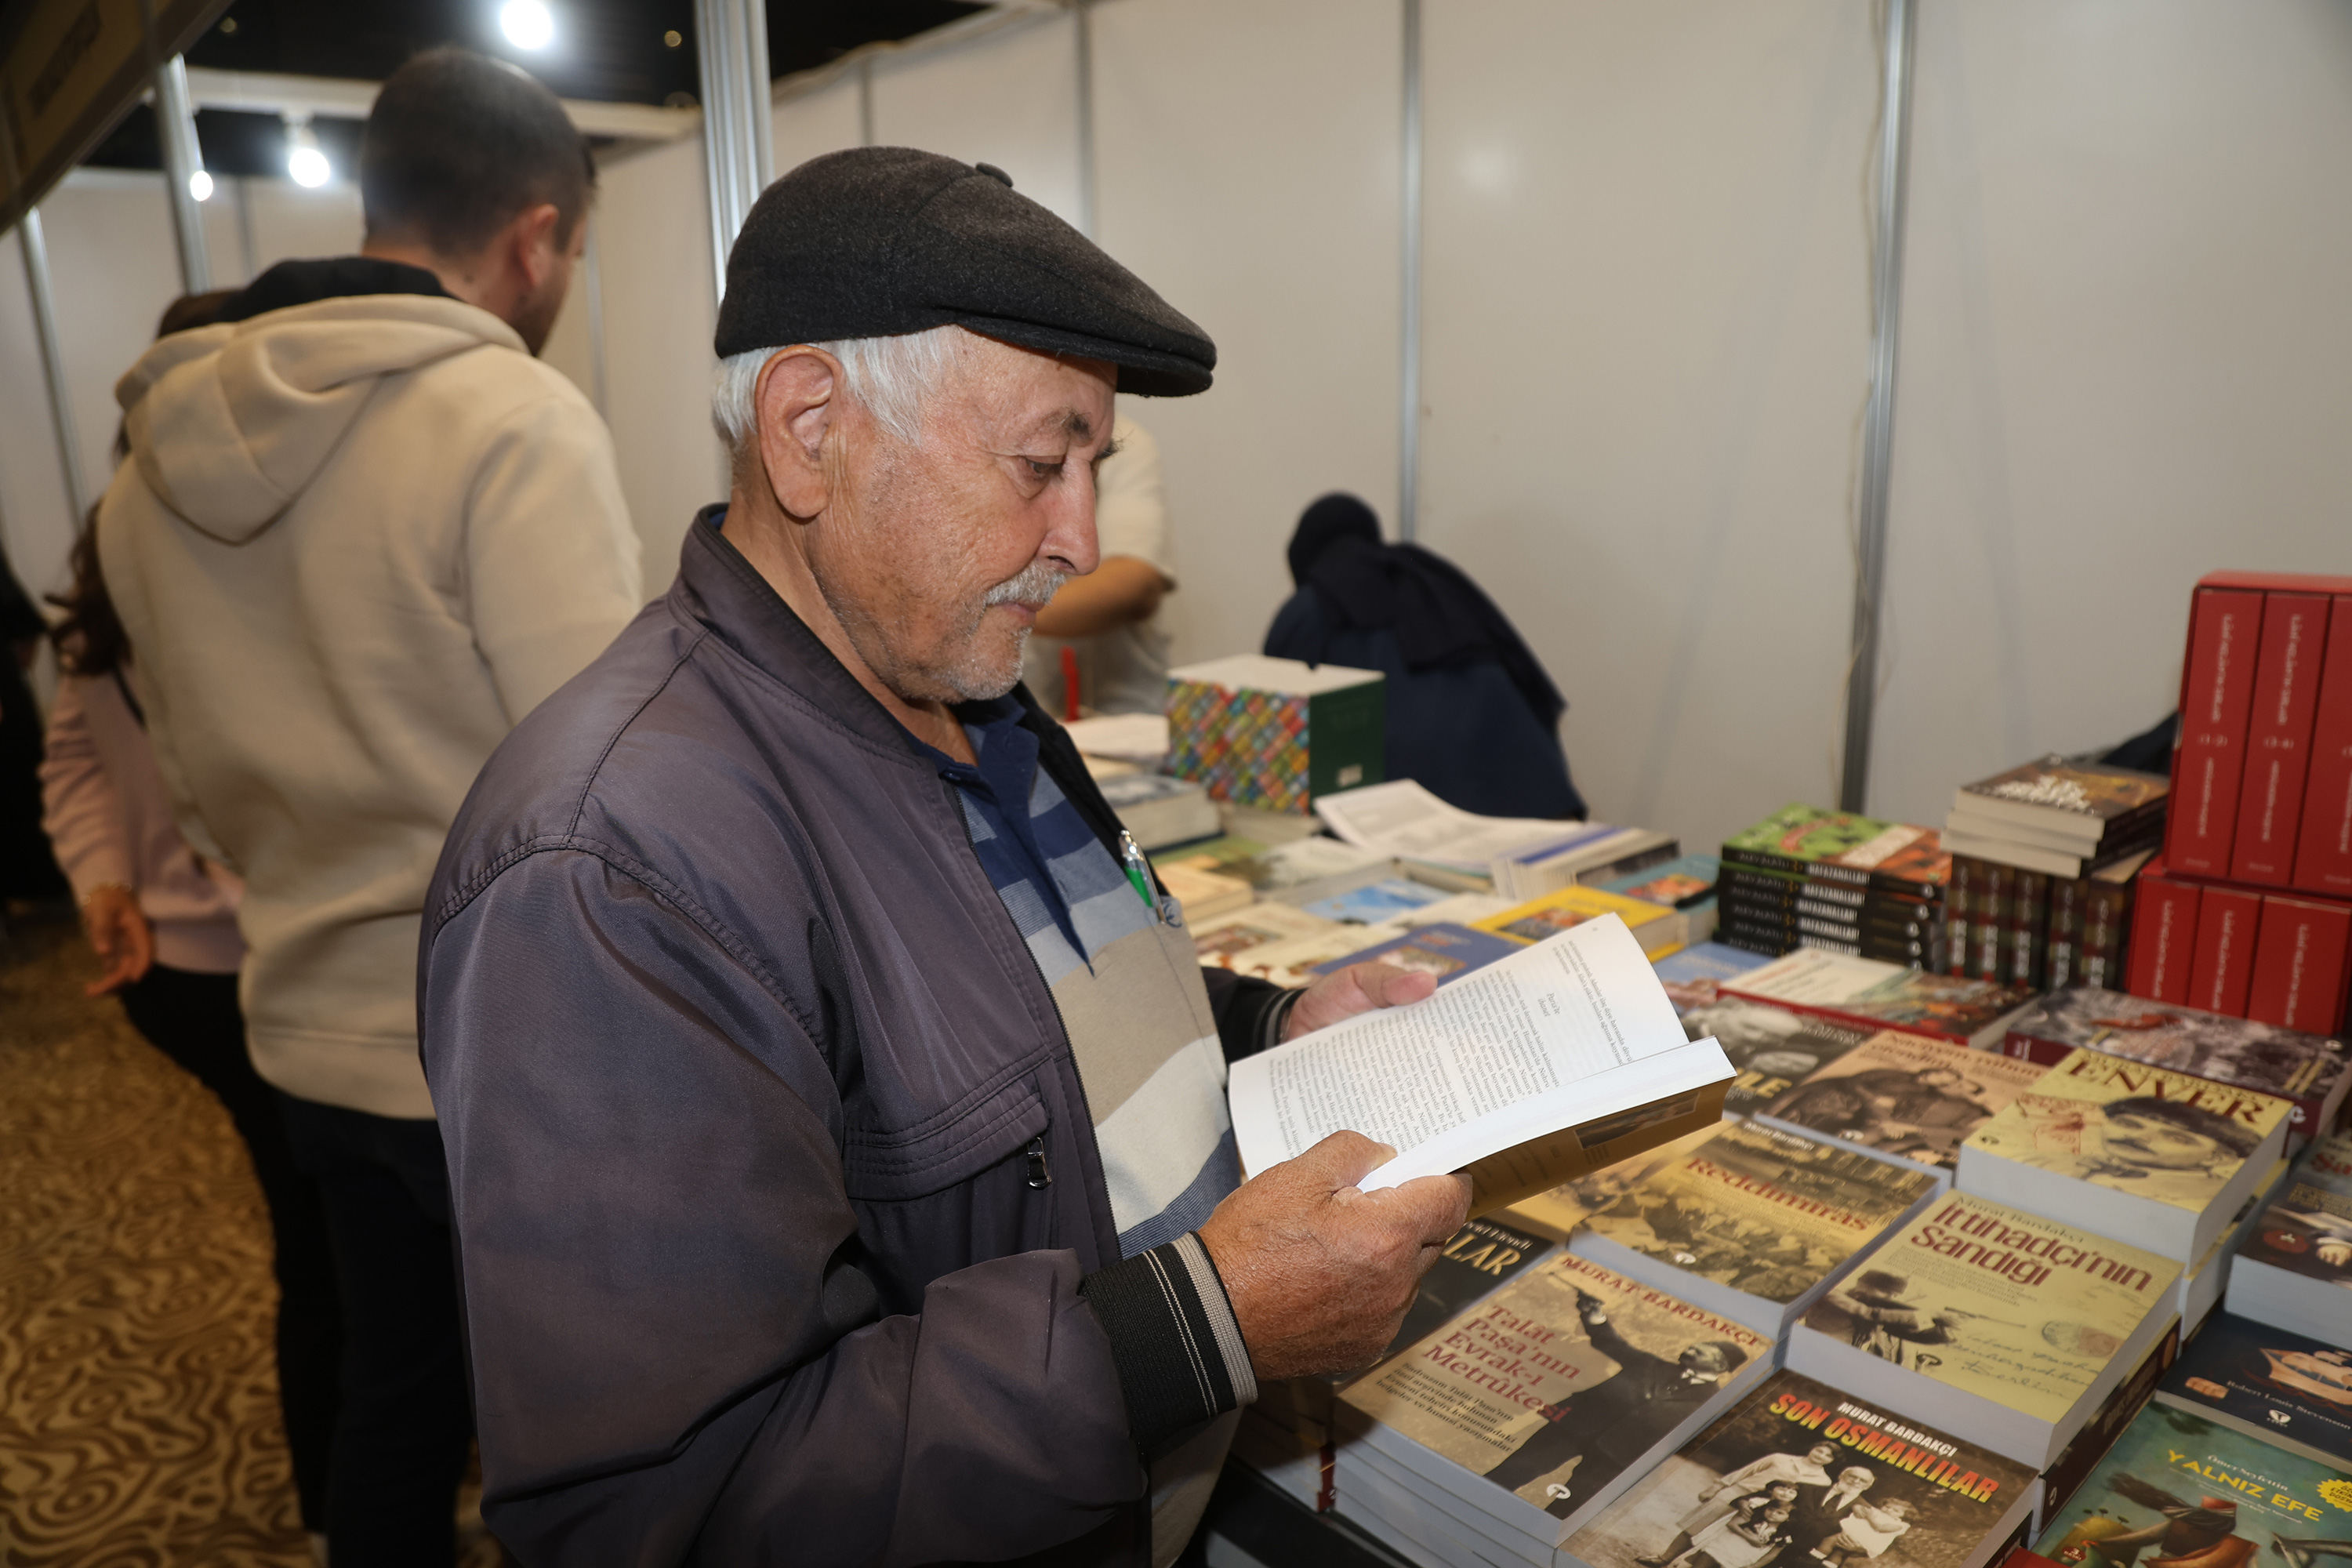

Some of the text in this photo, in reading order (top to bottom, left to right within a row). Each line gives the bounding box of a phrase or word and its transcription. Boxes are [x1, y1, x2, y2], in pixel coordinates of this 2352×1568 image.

[1806, 862, 1870, 884] HAFAZANALLAH!
[1803, 882, 1865, 906] HAFAZANALLAH!
[1798, 898, 1857, 924] HAFAZANALLAH!
[1800, 917, 1860, 941] HAFAZANALLAH!
[1537, 998, 1550, 1017] ihanet
[1546, 993, 1560, 1014] Paris'te
[1523, 1010, 1538, 1036] dayanacak
[1534, 1035, 1544, 1053] halim
[1600, 1021, 1613, 1042] ağzıma
[1604, 1007, 1613, 1018] diye
[1610, 1018, 1624, 1045] havanda
[1488, 1045, 1503, 1071] götürmek
[1499, 1045, 1510, 1065] arasına
[1512, 1029, 1533, 1071] kayınpederimle
[1523, 1030, 1541, 1065] Hindistan'da
[1538, 1066, 1549, 1087] Nehru
[1451, 1047, 1460, 1063] kuruş
[1461, 1075, 1472, 1095] nafaka
[1474, 1054, 1486, 1078] Nihayet
[1506, 1039, 1520, 1068] Başbakan,
[1519, 1069, 1533, 1094] Nizam'a
[1424, 1076, 1439, 1110] sevmektedir.
[1431, 1069, 1443, 1094] Kemal'in
[1440, 1094, 1453, 1118] Paris'te
[1468, 1067, 1486, 1102] evlenmemiz
[1490, 1072, 1504, 1098] boyunca
[2067, 1060, 2265, 1123] ENVER
[1376, 1105, 1388, 1128] evinden
[1391, 1091, 1404, 1120] Nelüfer'in
[1405, 1105, 1414, 1121] yaşar.
[1409, 1087, 1420, 1109] boşanır.
[1417, 1112, 1430, 1138] Nelüfer,
[1423, 1101, 1436, 1127] kocasını
[1449, 1091, 1460, 1112] birkaç
[1370, 1112, 1378, 1130] hasta
[1388, 1110, 1399, 1131] Paris'e
[1561, 1255, 1761, 1347] MURAT BARDAKÇI
[1487, 1305, 1555, 1345] Talât
[1441, 1331, 1544, 1388] Evrak-ı
[1464, 1318, 1581, 1380] Paşa'nın
[1421, 1344, 1574, 1423] Metrûkesi
[1385, 1374, 1419, 1395] Ermeni
[1451, 1409, 1518, 1443] konusundaki
[1457, 1401, 1497, 1424] bulunan
[1456, 1423, 1513, 1452] yazışmalar
[1837, 1402, 1958, 1457] MURAT BARDAKÇI
[1769, 1393, 1999, 1504] SON OSMANLILAR
[2169, 1449, 2266, 1498] YALNIZ
[2270, 1493, 2323, 1522] EFE
